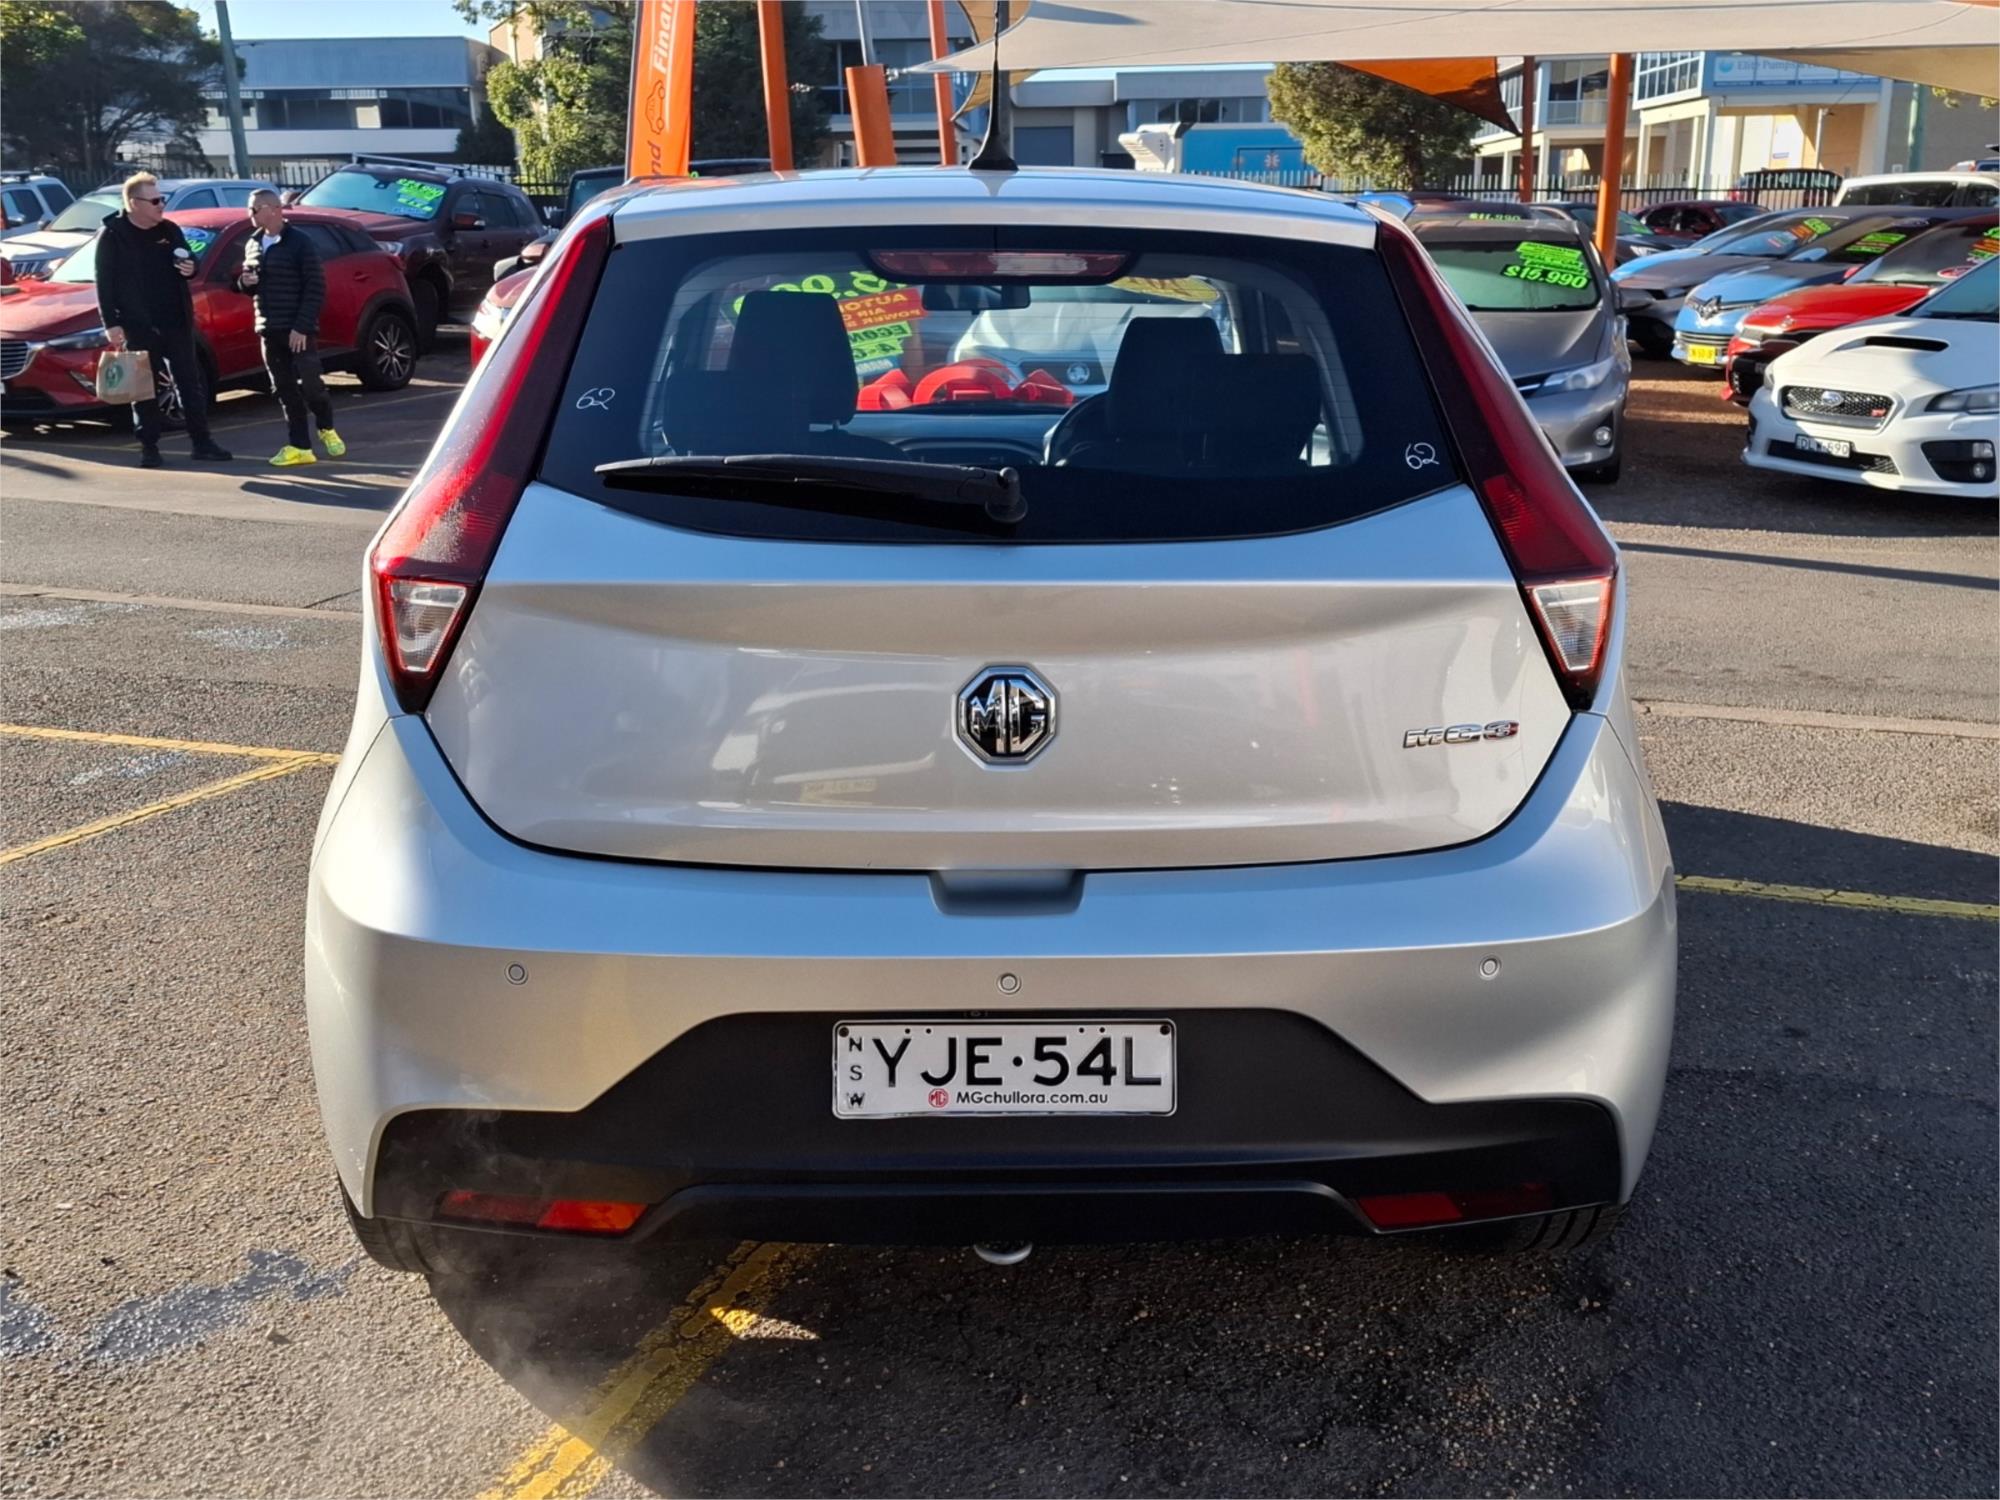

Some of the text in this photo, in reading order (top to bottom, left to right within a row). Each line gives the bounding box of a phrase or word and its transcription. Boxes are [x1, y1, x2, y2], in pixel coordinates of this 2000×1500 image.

[1503, 265, 1588, 289] $15.990
[576, 387, 616, 410] 62
[1405, 442, 1439, 470] 62
[970, 679, 1045, 753] MG
[1402, 720, 1519, 749] MG3
[956, 1091, 1108, 1105] MGchullora.com.au
